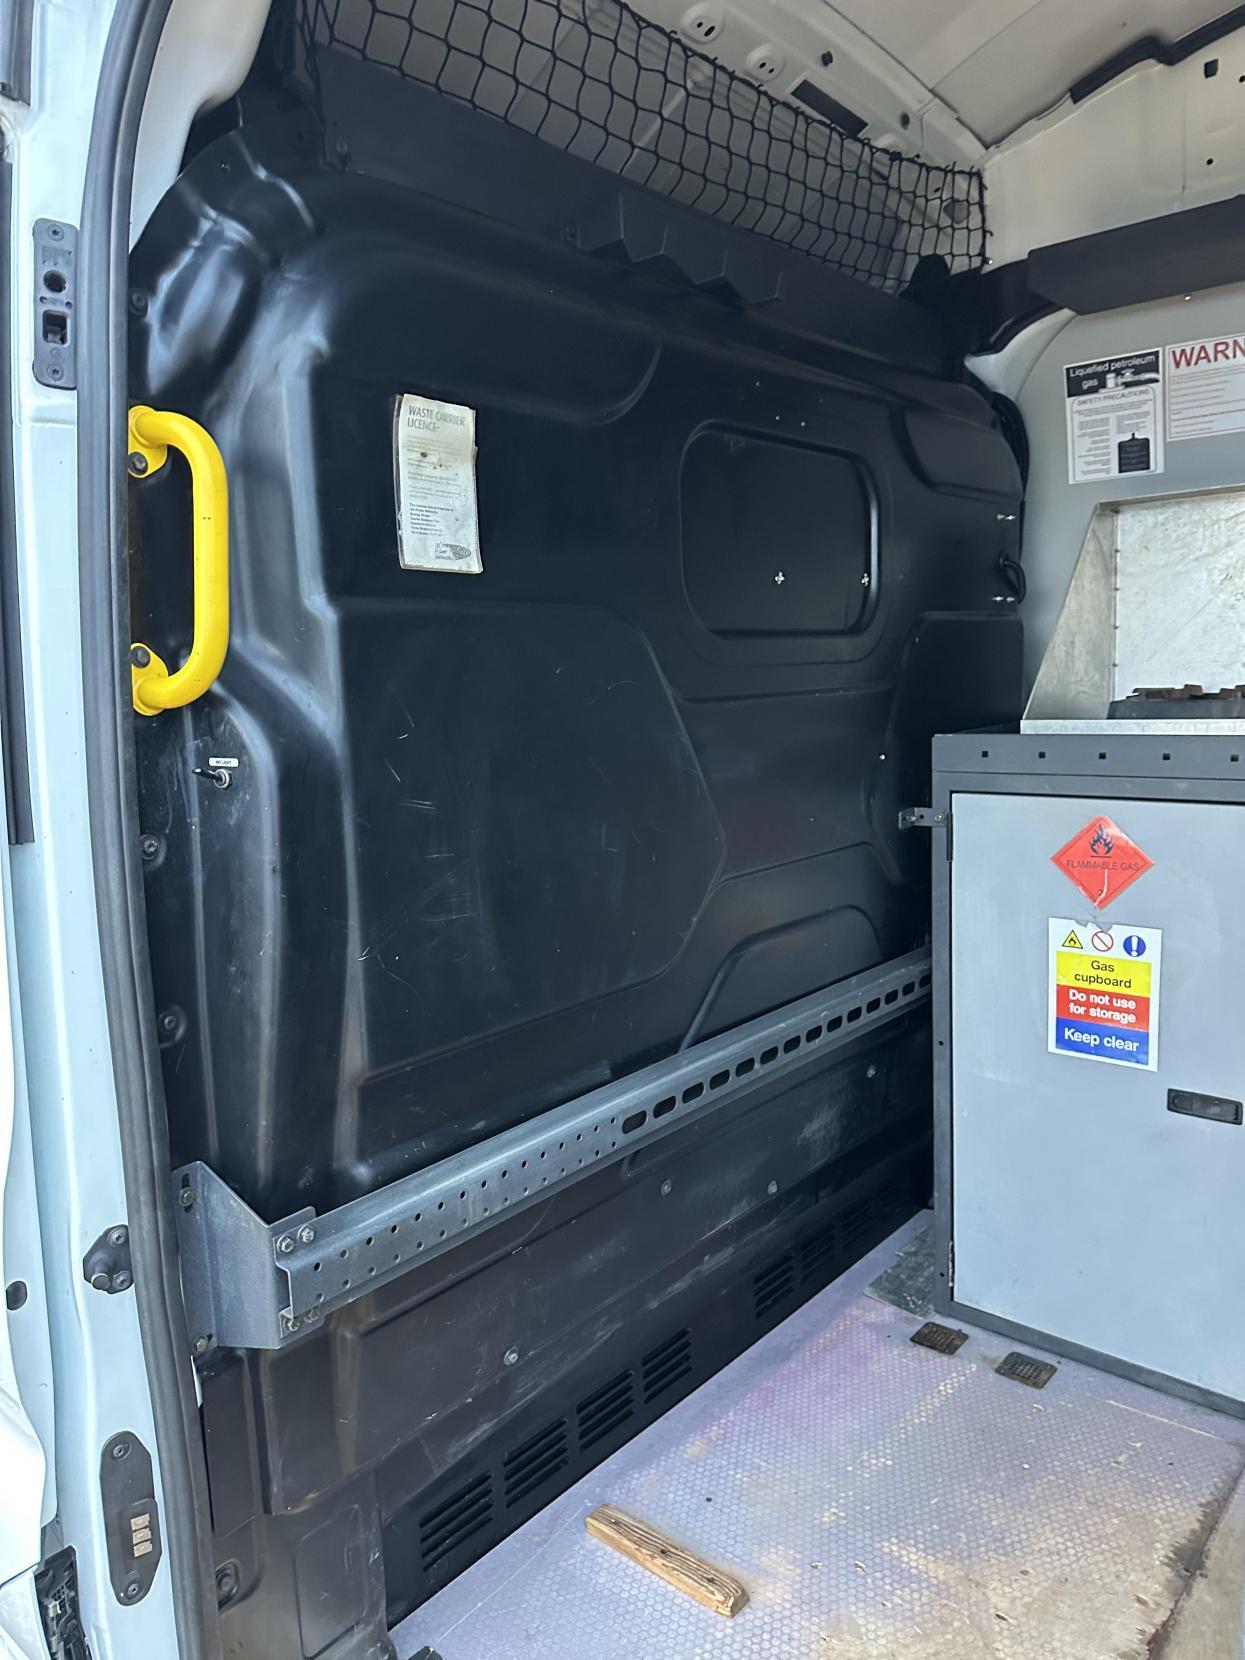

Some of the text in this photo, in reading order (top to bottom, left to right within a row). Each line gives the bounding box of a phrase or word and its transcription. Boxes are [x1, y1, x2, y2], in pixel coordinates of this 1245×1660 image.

[1172, 339, 1245, 369] WARN
[1069, 354, 1156, 378] Liquefied petroleum
[1081, 379, 1099, 389] gas
[1077, 388, 1150, 406] SAFETY PRECAUTIONS
[407, 417, 438, 432] LICENCE
[408, 404, 466, 426] WASTE CARRIER
[1066, 859, 1139, 872] FLAMMABLE GAS
[1091, 960, 1115, 972] Gas
[1074, 973, 1132, 988] cupboard
[1069, 988, 1137, 1010] Do not use
[1069, 1003, 1137, 1024] for storage
[1064, 1027, 1140, 1052] Keep clear
